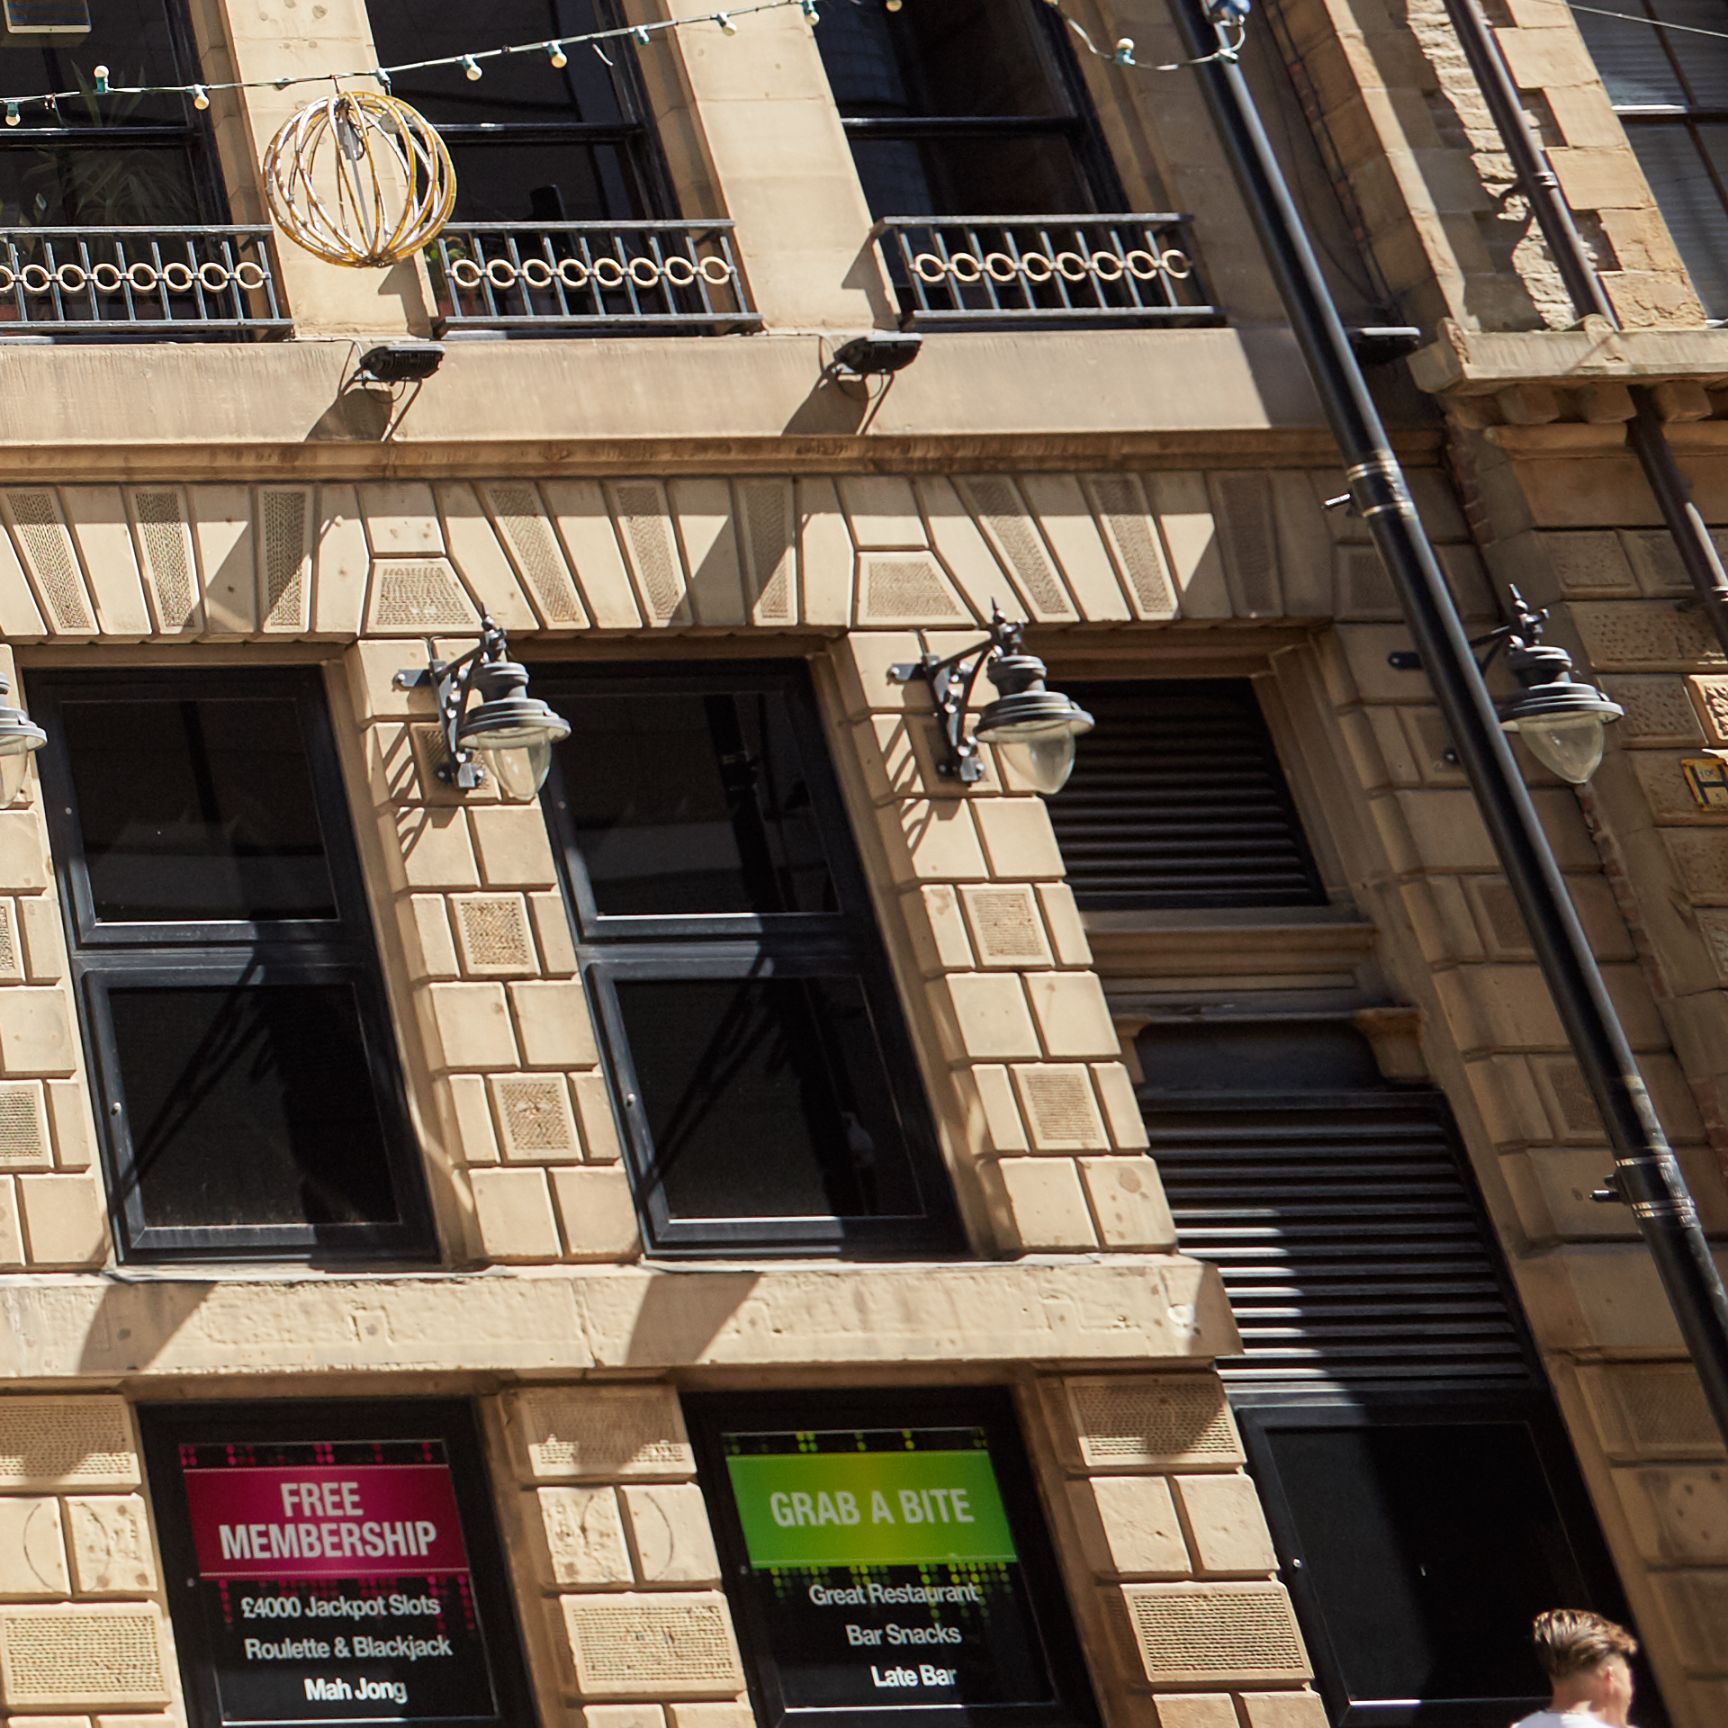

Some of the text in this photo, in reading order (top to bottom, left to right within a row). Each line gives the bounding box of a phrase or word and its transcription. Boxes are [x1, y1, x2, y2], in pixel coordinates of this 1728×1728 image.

[280, 1481, 364, 1517] FREE
[770, 1488, 975, 1527] GRAB A BITE
[219, 1521, 437, 1560] MEMBERSHIP
[240, 1594, 442, 1621] £4000 Jackpot Slots
[808, 1582, 979, 1606] Great Restaurant
[845, 1623, 962, 1646] Bar Snacks
[244, 1635, 453, 1662] Roulette & Blackjack
[870, 1664, 958, 1687] Late Bar
[304, 1677, 408, 1704] Mah Jong
